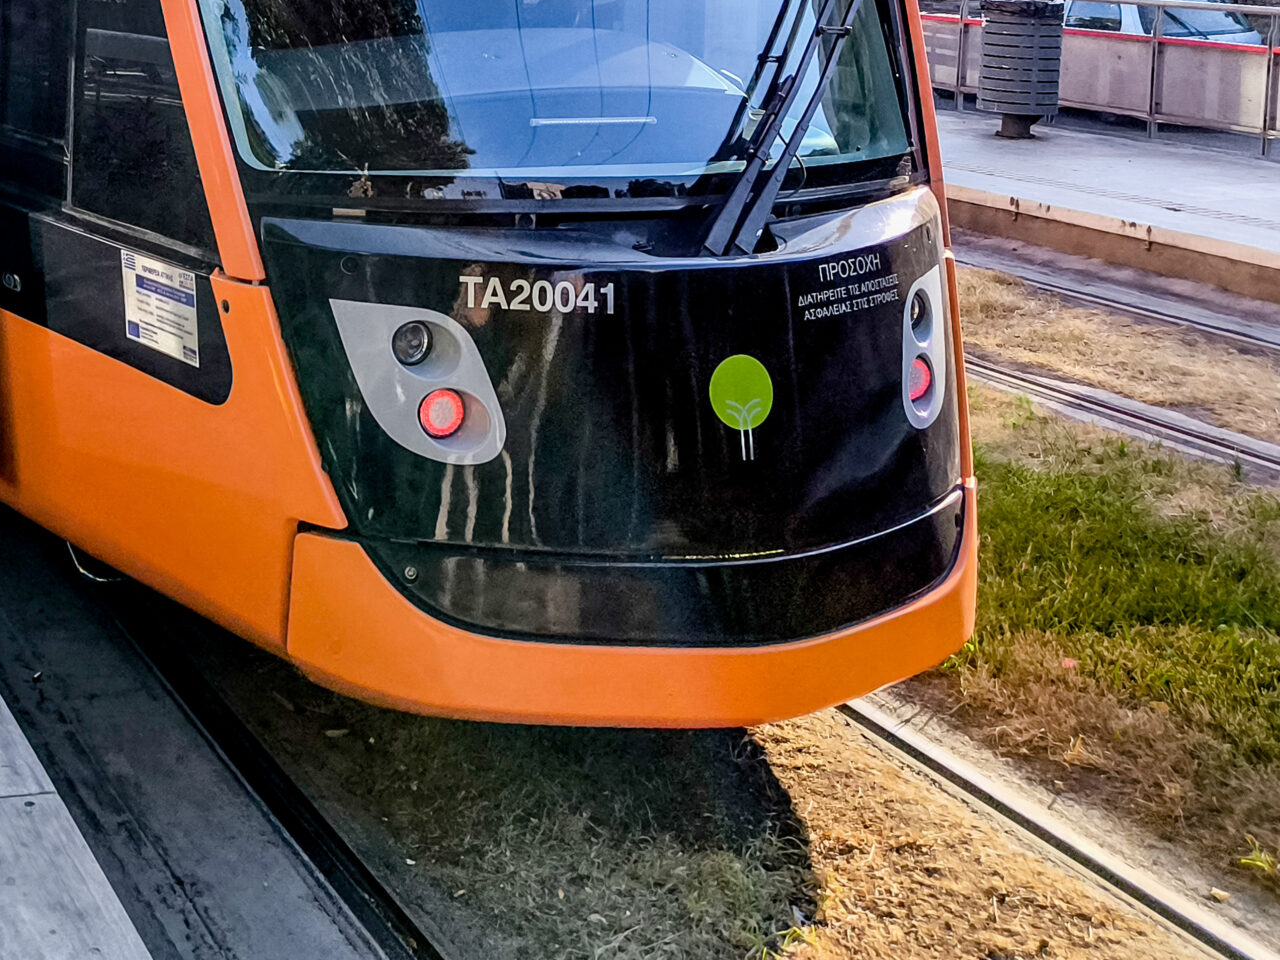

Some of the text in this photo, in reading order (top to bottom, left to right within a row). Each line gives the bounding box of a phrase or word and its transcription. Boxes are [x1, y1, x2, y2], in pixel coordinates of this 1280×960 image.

[818, 252, 882, 283] ΠΡΟΣΟΧΗ
[458, 275, 615, 315] TA20041
[798, 273, 899, 307] ΔΙΑΤΗΡΕΙΤΕ ΤΙΣ ΑΠΟΣΤΑΣΕΙΣ
[803, 288, 899, 321] ΑΣΦΑΛΕΙΑΣ ΣΤΙΣ ΣΤΡΟΦΕΣ
